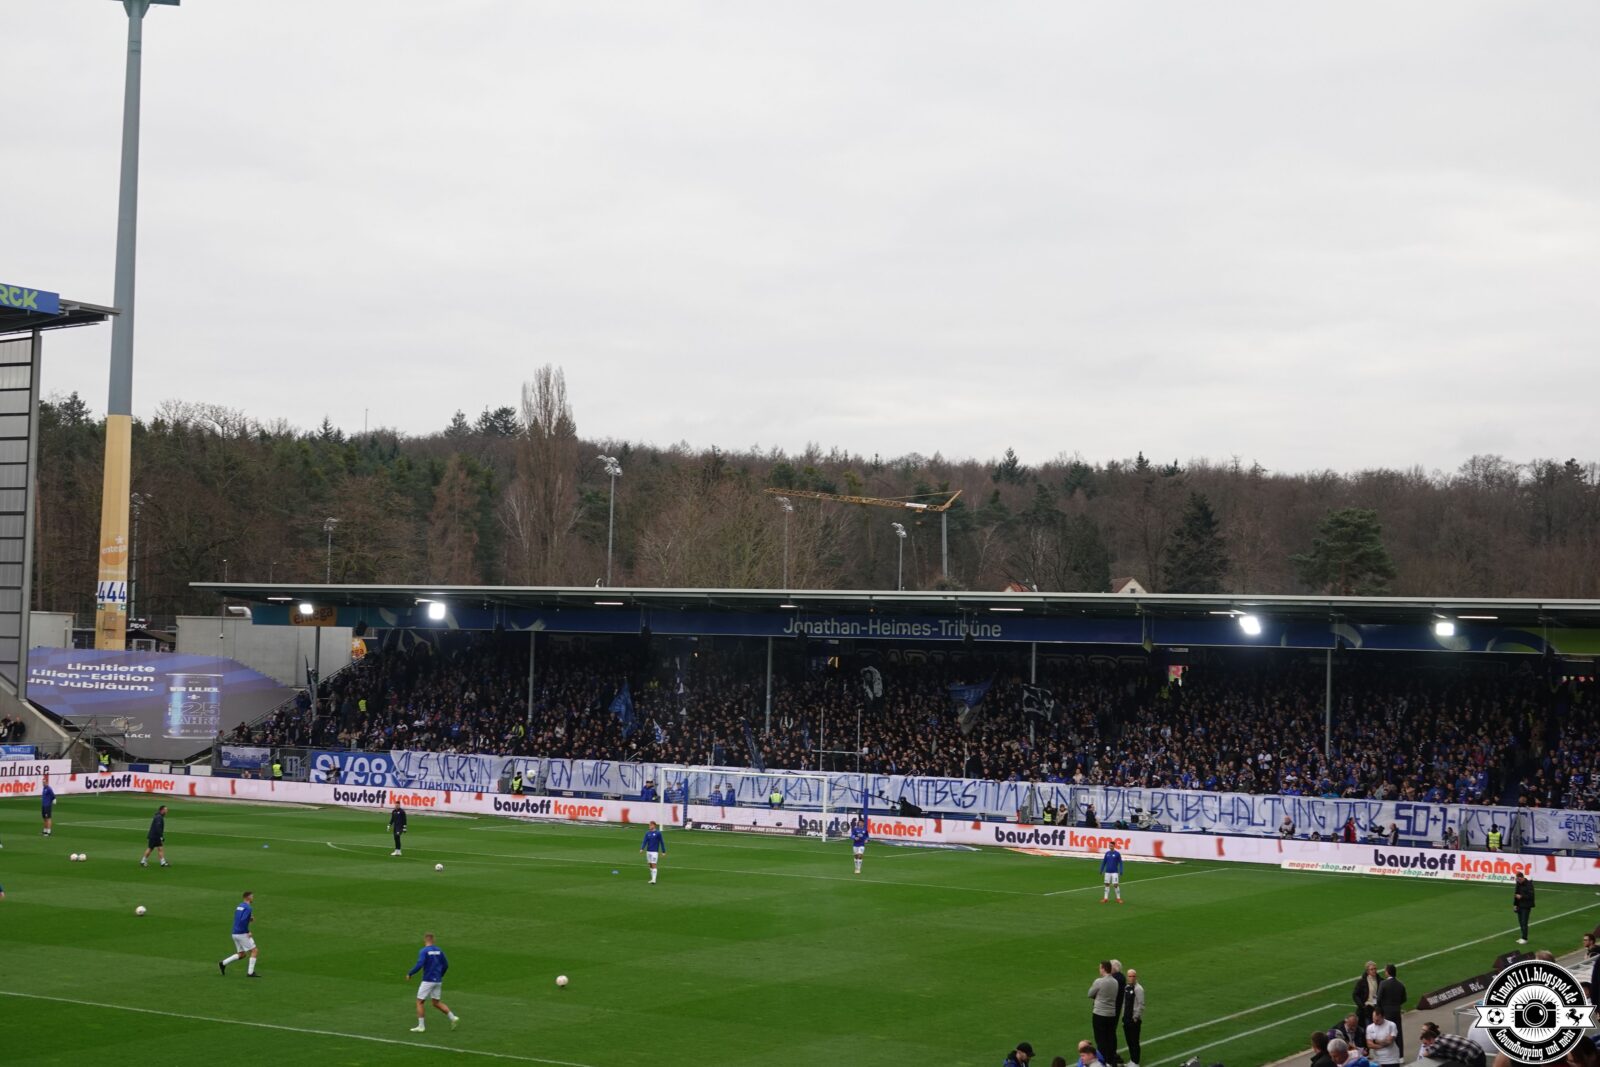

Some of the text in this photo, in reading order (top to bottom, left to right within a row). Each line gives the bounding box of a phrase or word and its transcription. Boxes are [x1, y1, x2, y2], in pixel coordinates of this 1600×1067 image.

[97, 582, 126, 602] 444
[783, 617, 1002, 637] Jonathan-Heimes-Tribüne
[32, 669, 155, 682] Lilien-Edition
[67, 663, 156, 673] Limitierte
[59, 680, 154, 692] Jubiläum.
[315, 754, 387, 787] SV98
[85, 774, 175, 791] baustoff kramer
[436, 753, 492, 785] VEREIN
[581, 762, 612, 788] WIR
[1151, 791, 1326, 829] BEIBEHALTUNG
[333, 787, 436, 807] baustoff kramer
[494, 796, 604, 818] baustoff kramer
[867, 818, 923, 838] kramer
[995, 826, 1131, 850] baustoff kramer
[1567, 830, 1594, 843] SV98
[1288, 861, 1356, 872] magnet-shop.net
[1369, 867, 1439, 878] magnet-shop.net
[1373, 849, 1532, 876] baustoff kramer
[1453, 871, 1516, 882] magnet-shop.n
